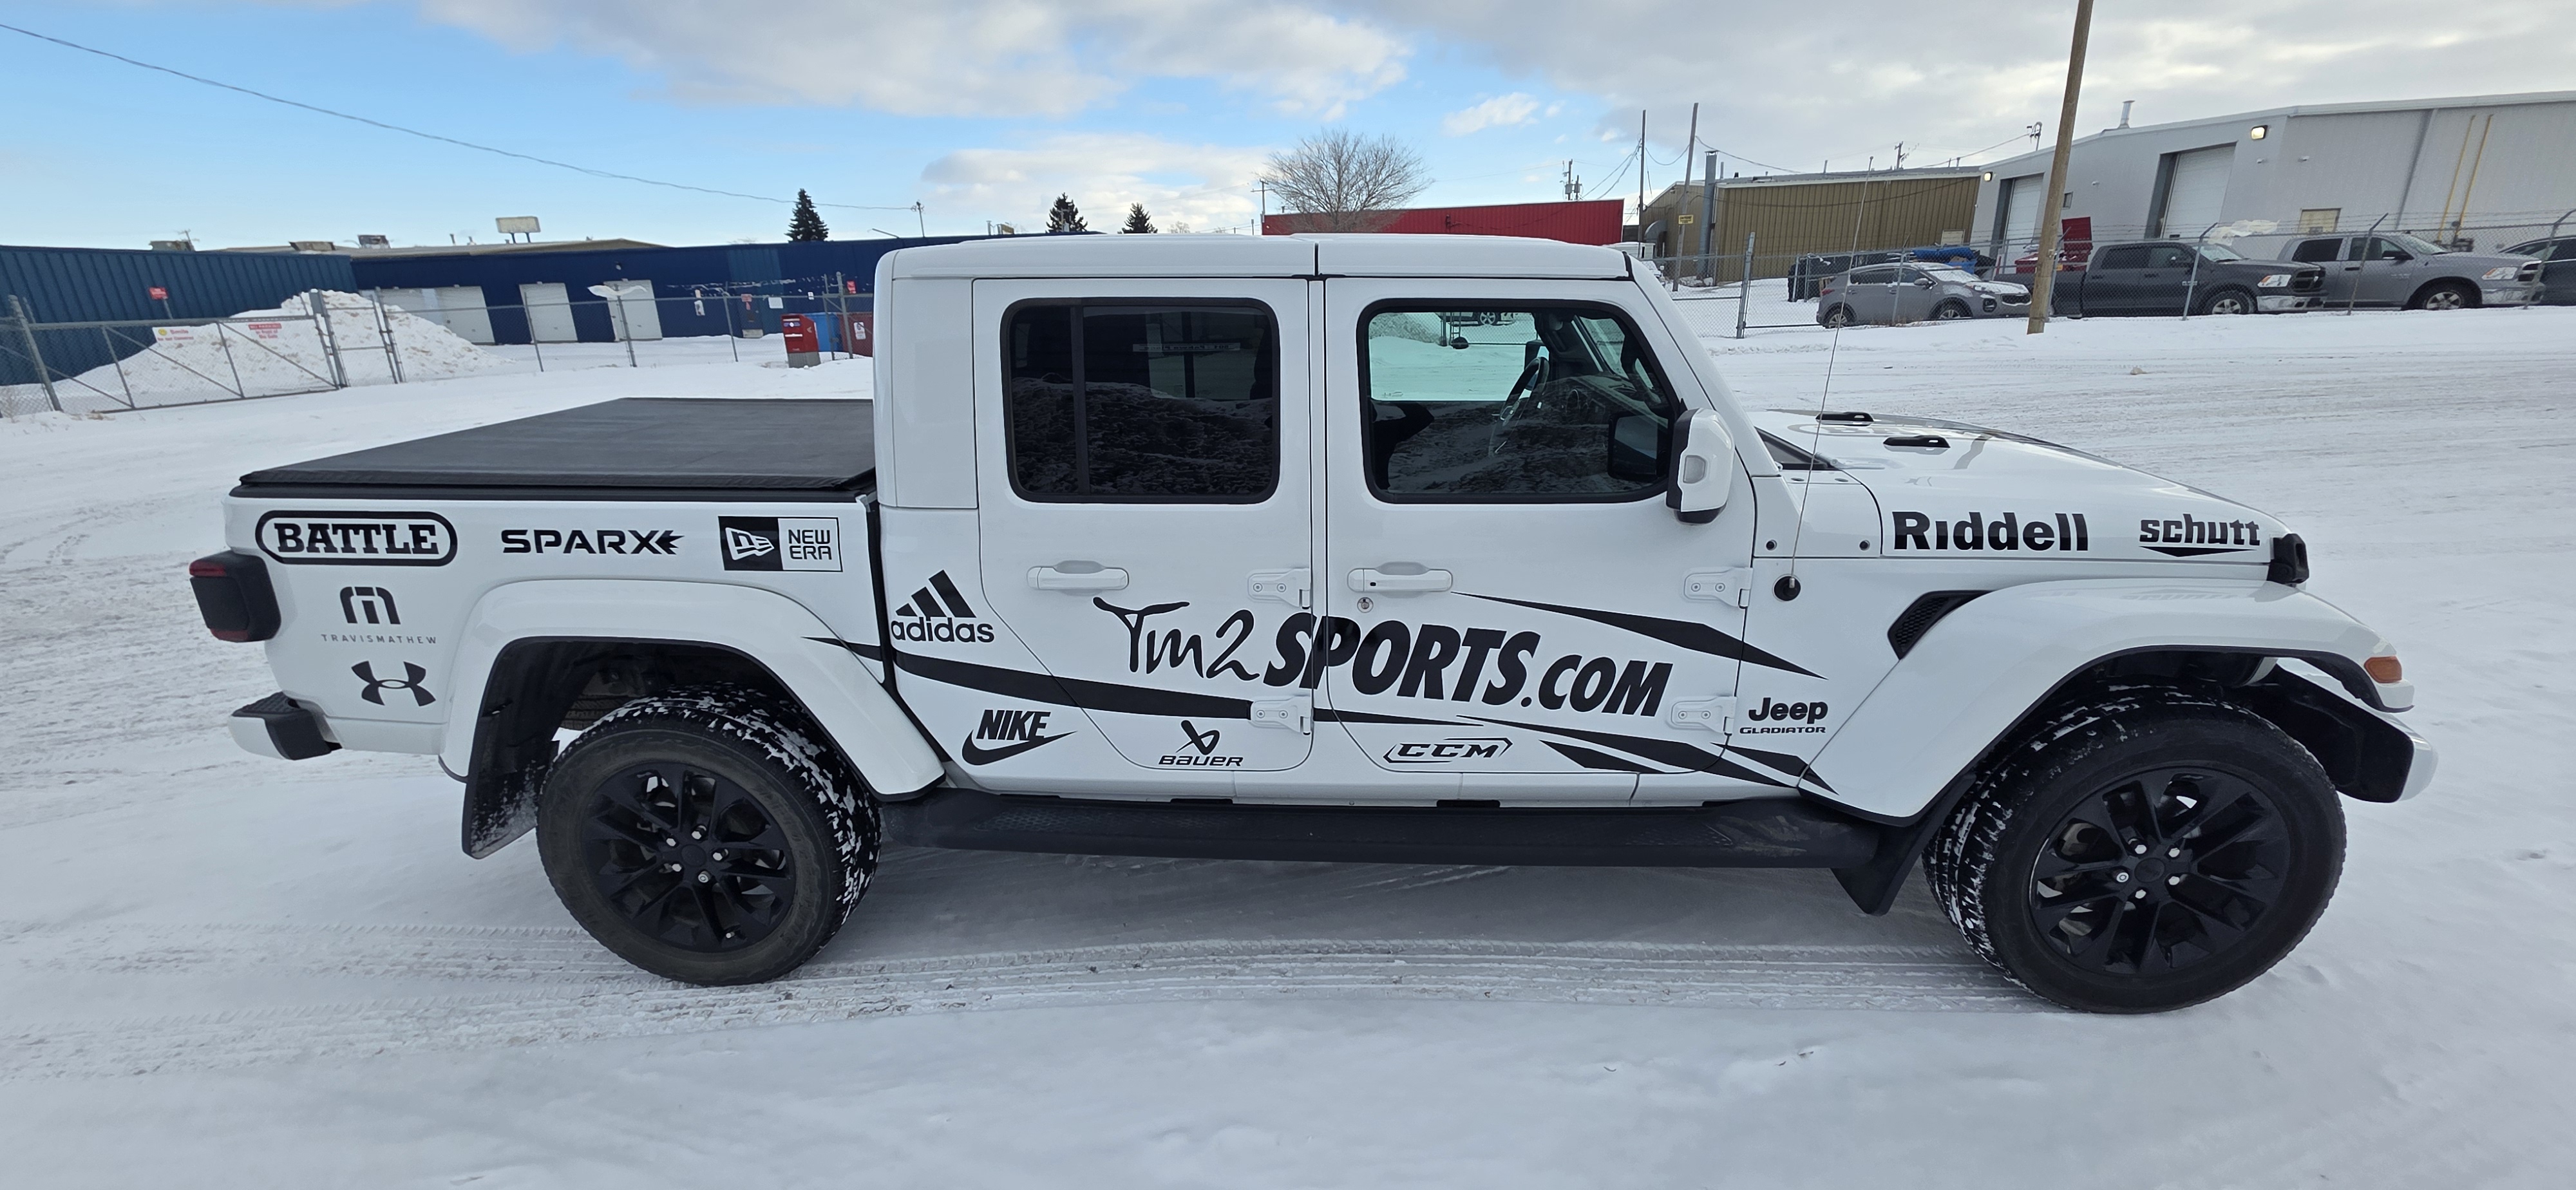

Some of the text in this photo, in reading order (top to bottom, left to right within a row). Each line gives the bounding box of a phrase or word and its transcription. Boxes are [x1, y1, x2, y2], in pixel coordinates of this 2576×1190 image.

[274, 522, 440, 554] BATTLE
[502, 529, 683, 555] SPARX
[788, 528, 831, 545] NEW
[1892, 511, 2088, 551] Riddell
[2139, 513, 2260, 546] schutt
[789, 545, 832, 560] ERA
[321, 633, 437, 645] TRAVISMATHEW
[891, 616, 995, 643] adidas
[1748, 697, 1828, 724] Jeep
[976, 710, 1051, 741] NIKE
[1739, 726, 1826, 734] GLADIATOR
[1397, 742, 1499, 759] CCM
